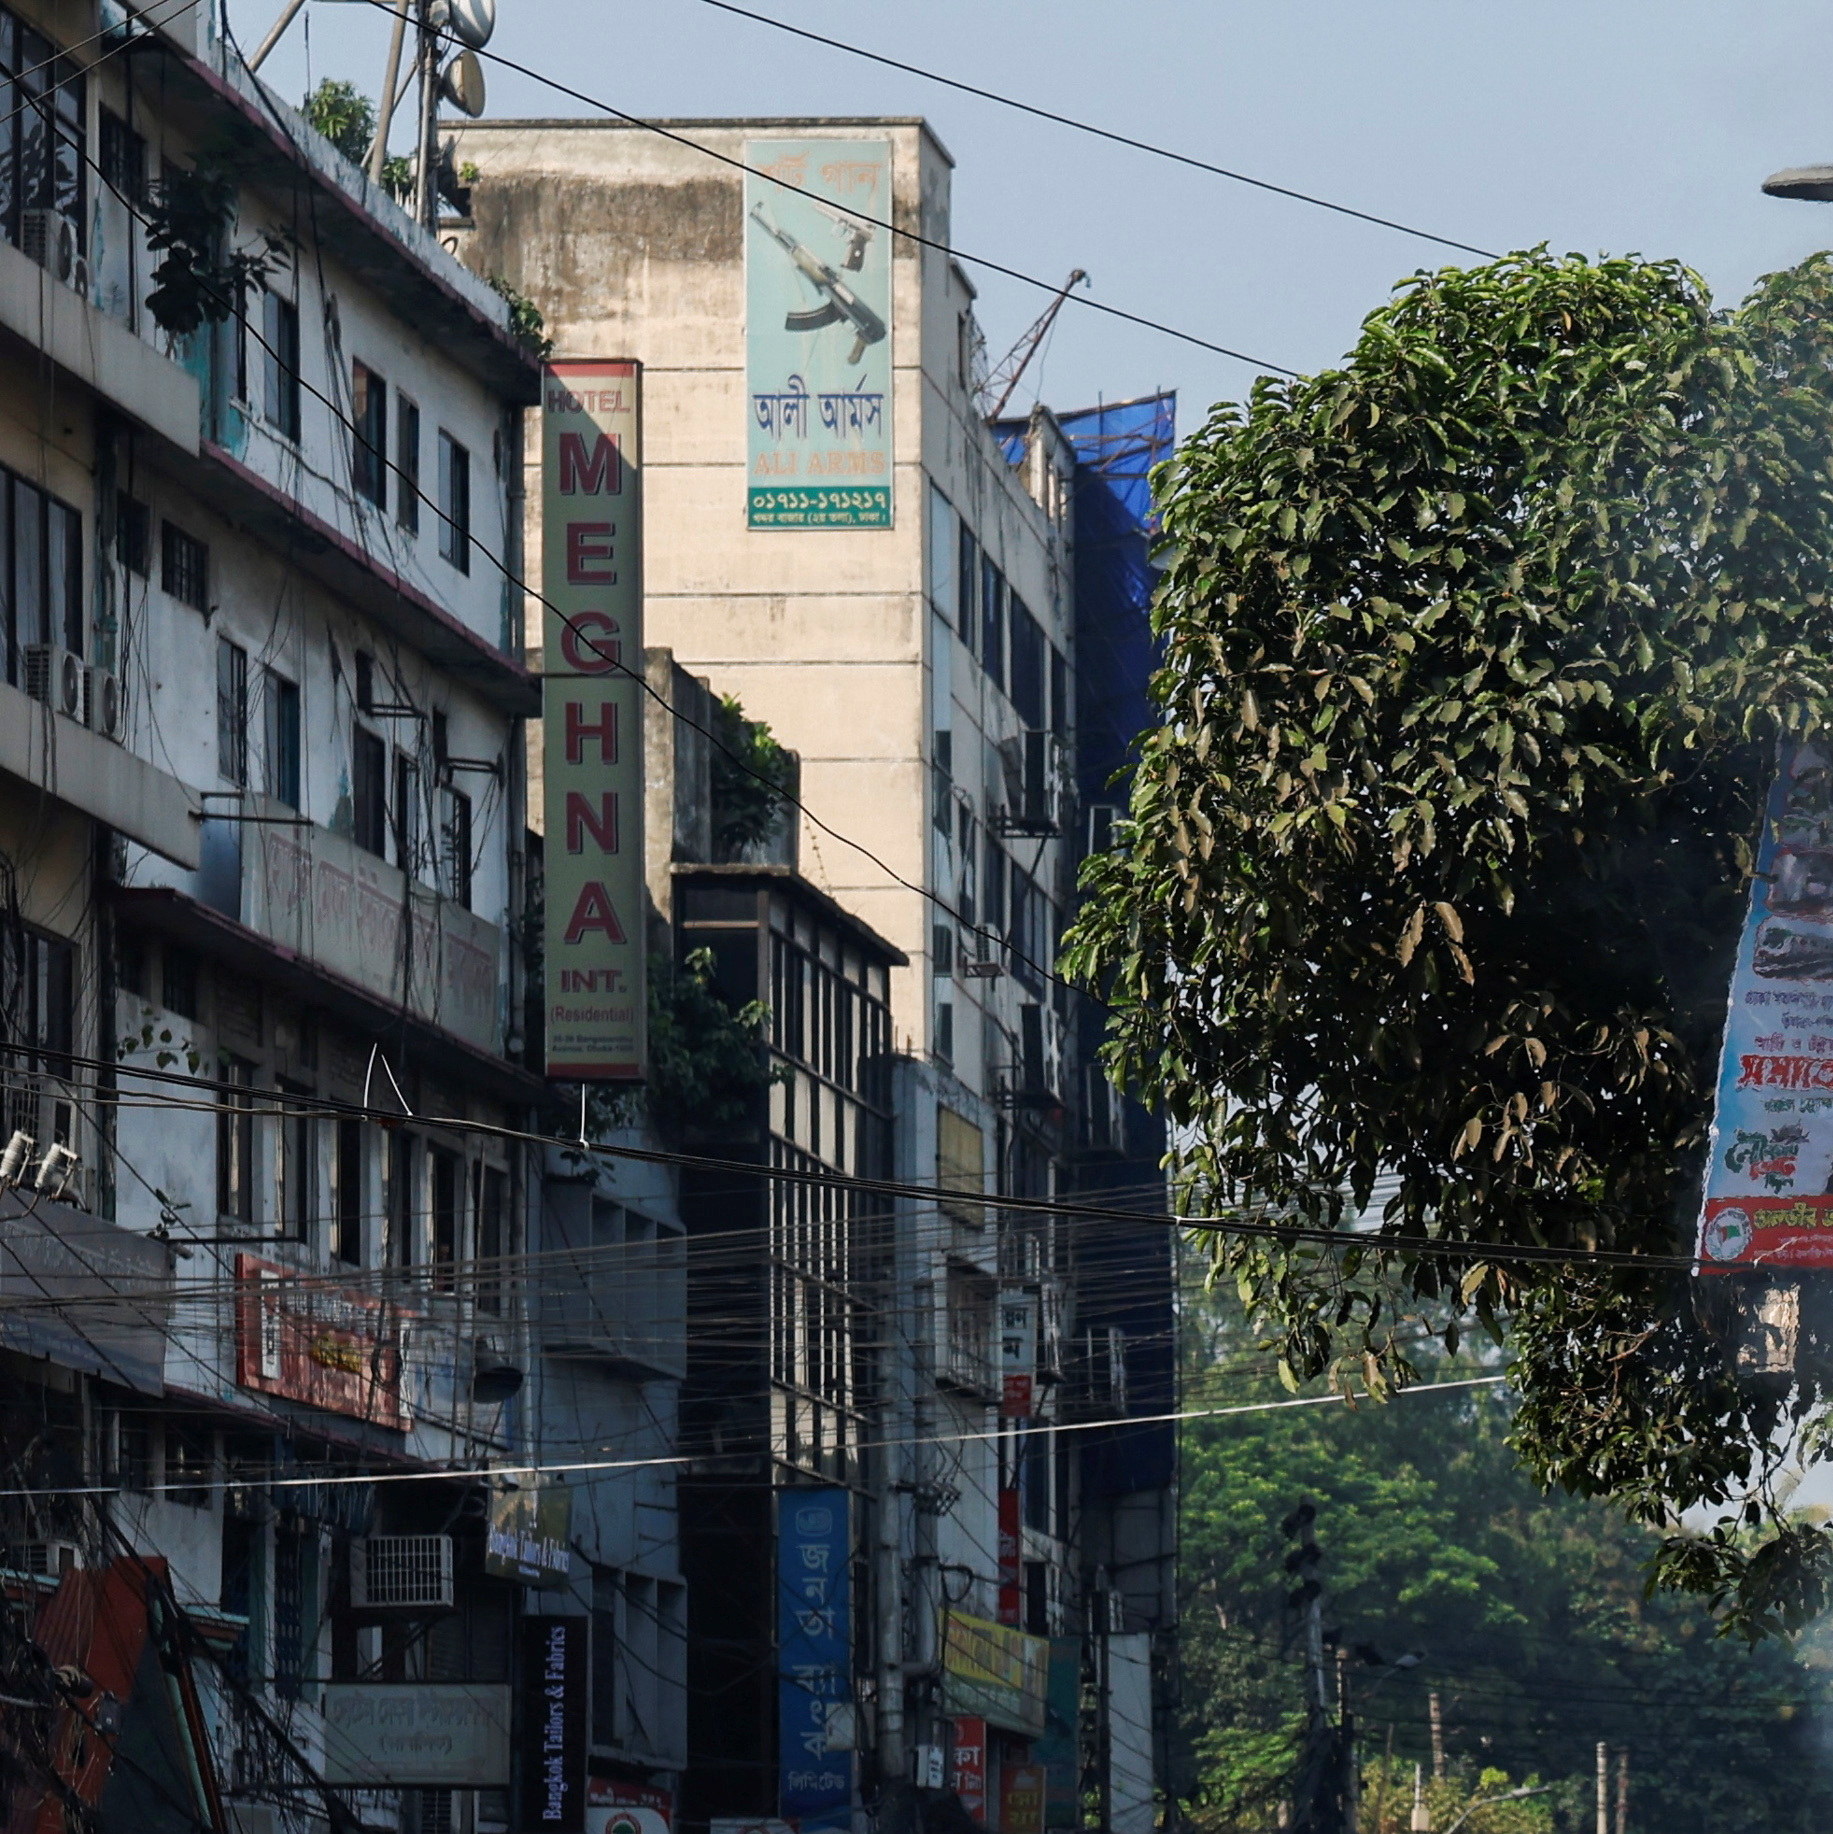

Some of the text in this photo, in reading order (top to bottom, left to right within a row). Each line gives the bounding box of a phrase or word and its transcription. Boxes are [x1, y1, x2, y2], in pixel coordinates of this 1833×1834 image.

[548, 390, 631, 414] HOTEL
[753, 374, 810, 441] আলী
[754, 452, 886, 475] ALI ARMS
[560, 432, 627, 945] MEGHNA
[560, 970, 629, 993] INT.
[551, 1006, 634, 1024] (Residential)
[542, 1625, 569, 1821] Bangkok Tailors & Fabrics
